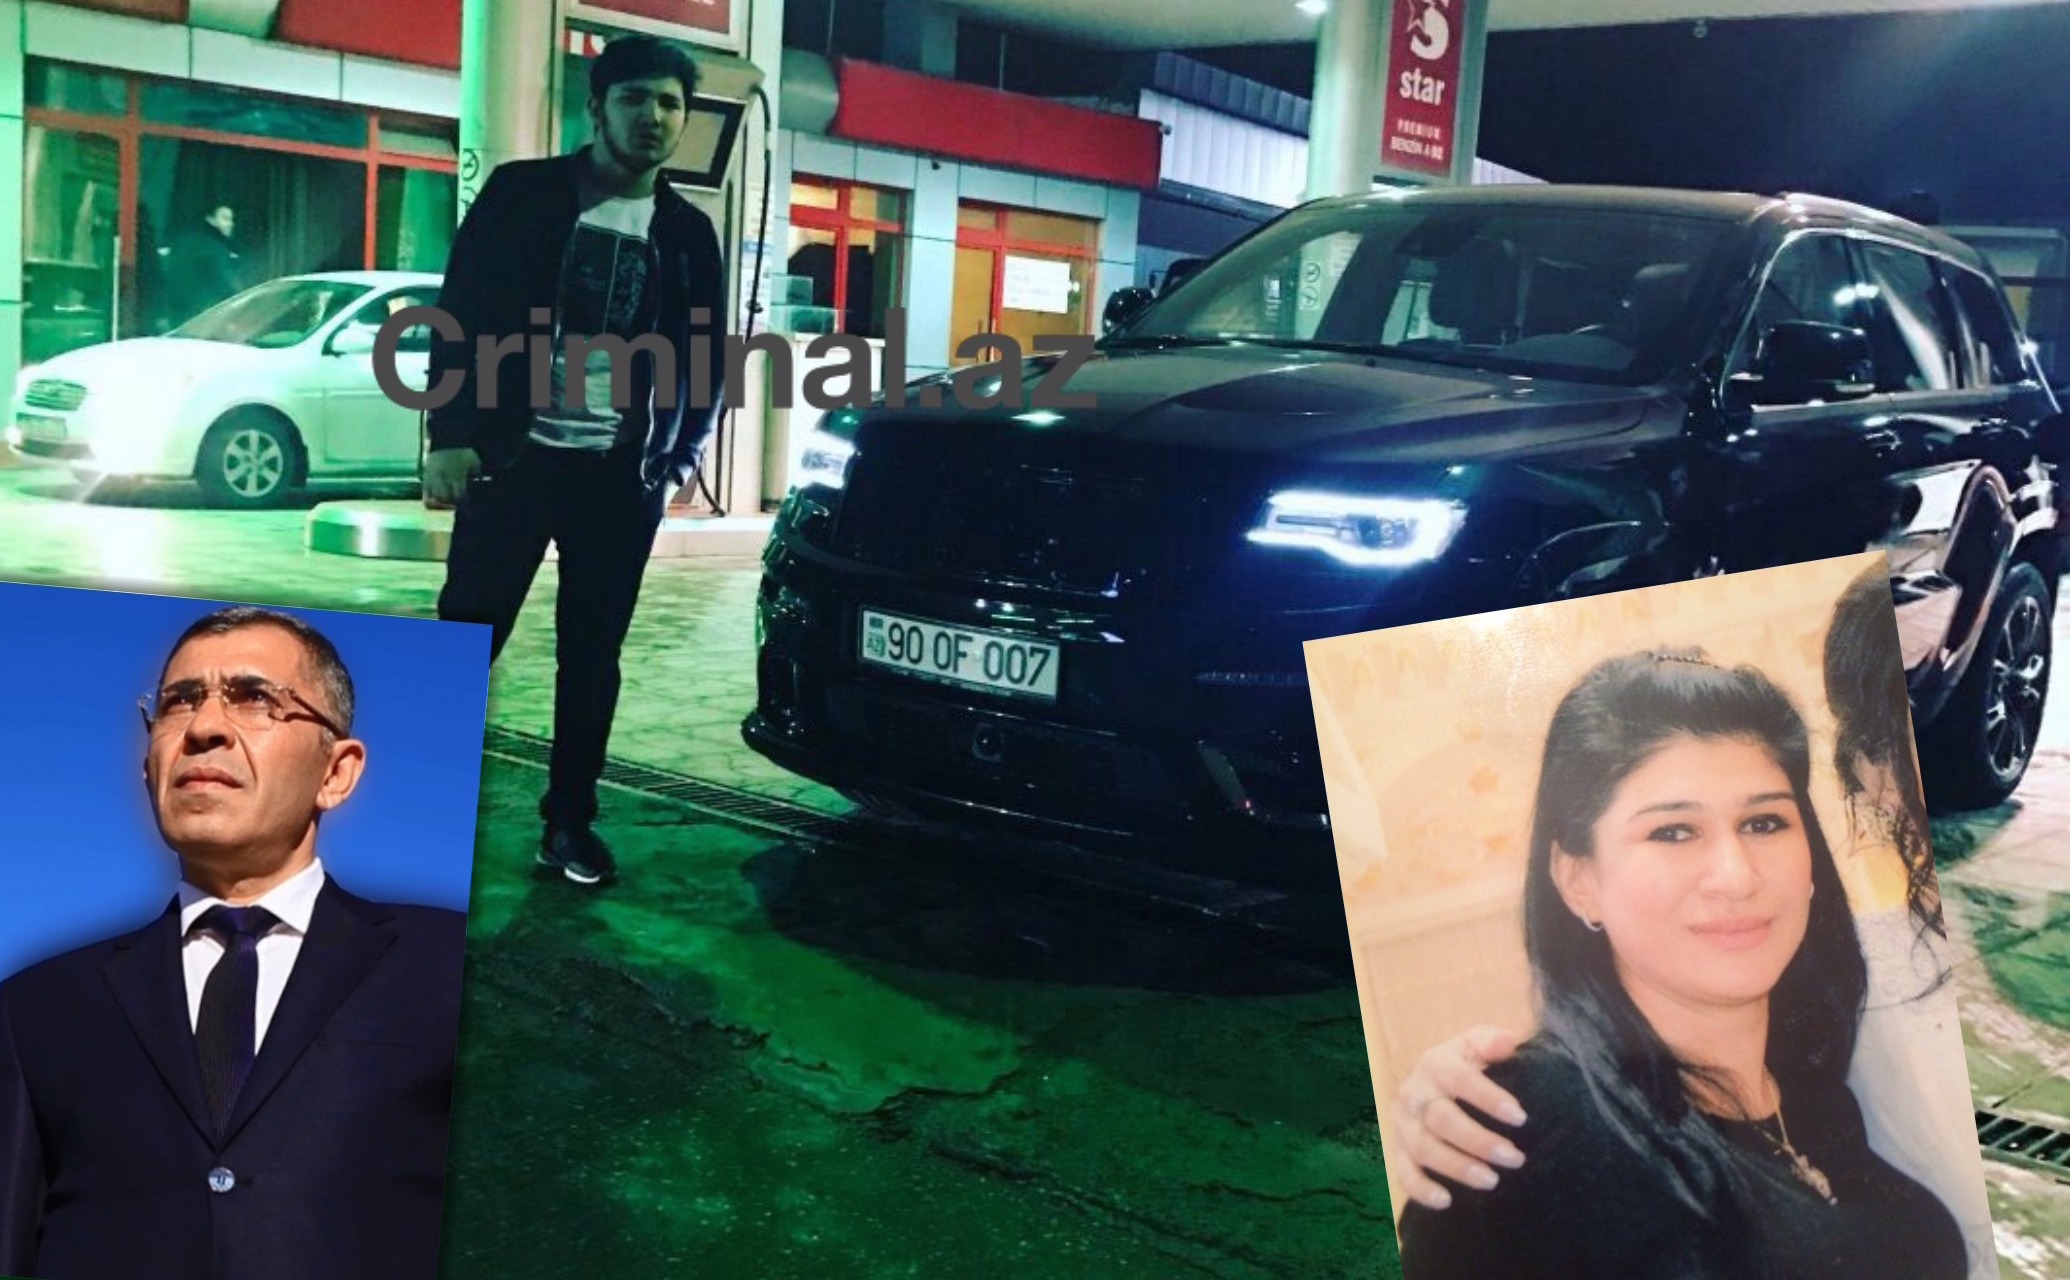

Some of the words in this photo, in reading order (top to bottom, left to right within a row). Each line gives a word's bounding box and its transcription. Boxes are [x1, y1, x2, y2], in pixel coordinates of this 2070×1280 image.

[1399, 68, 1446, 106] star
[888, 622, 924, 664] 90
[983, 640, 1051, 686] 007
